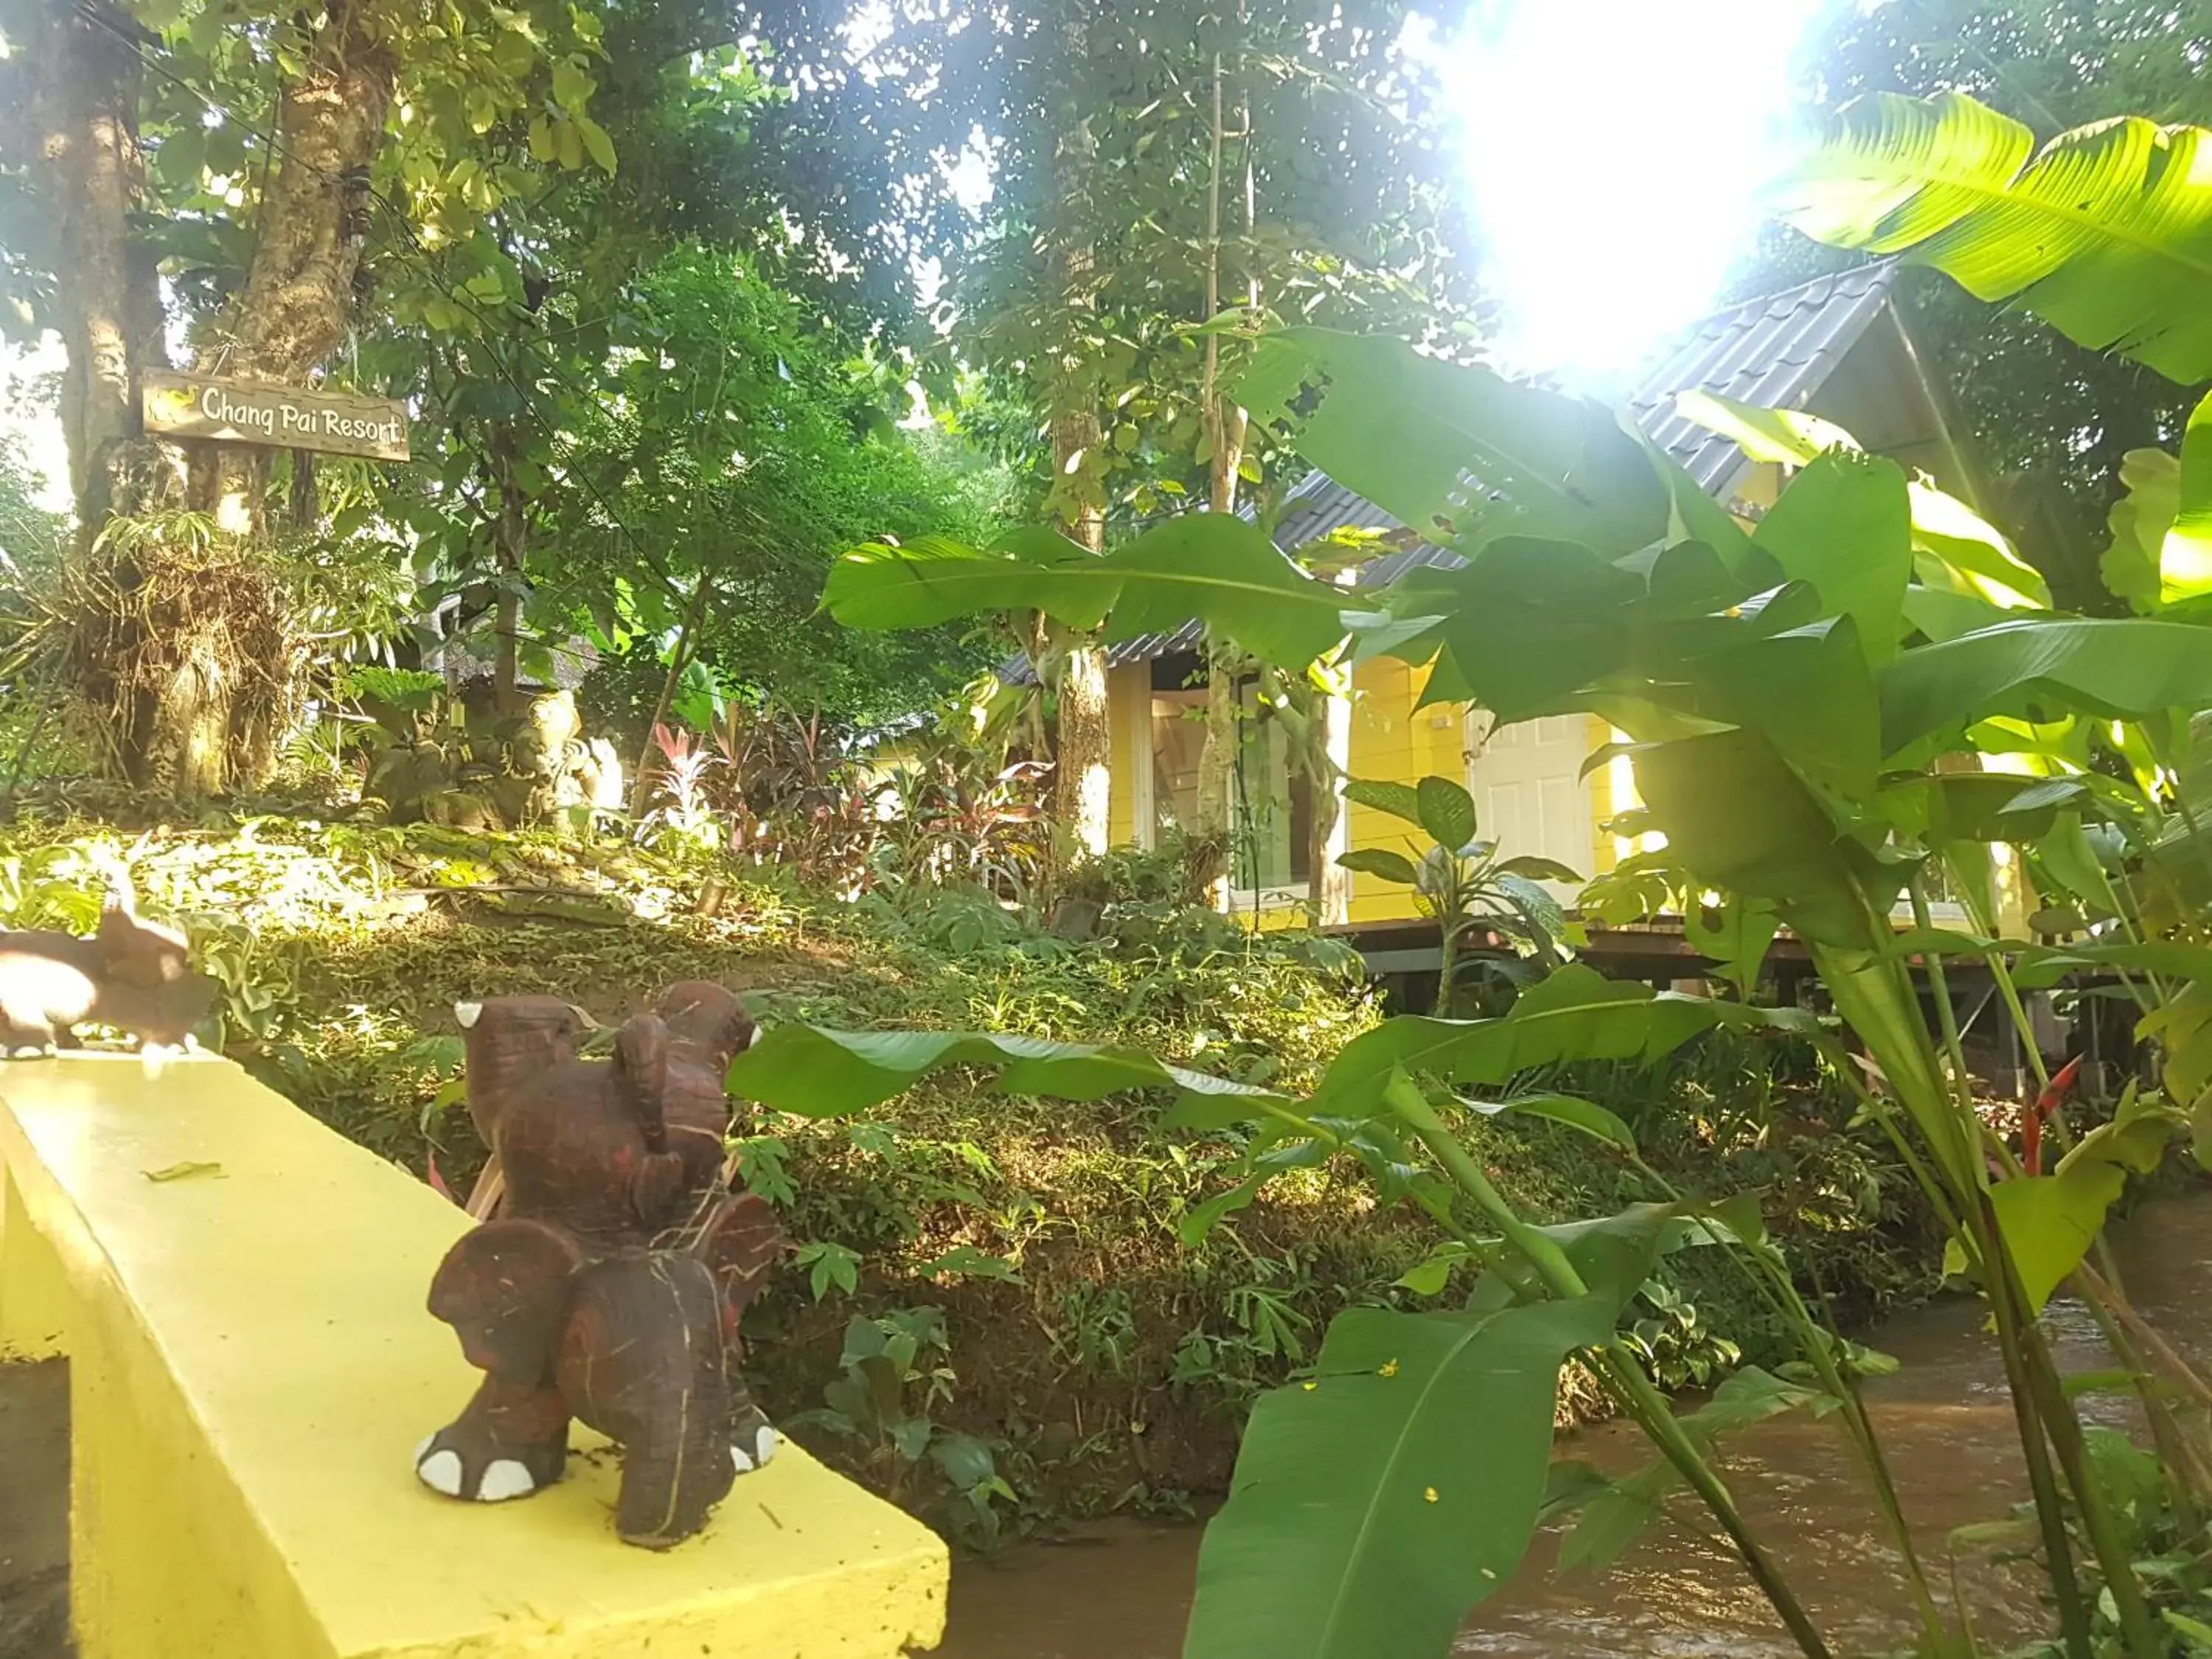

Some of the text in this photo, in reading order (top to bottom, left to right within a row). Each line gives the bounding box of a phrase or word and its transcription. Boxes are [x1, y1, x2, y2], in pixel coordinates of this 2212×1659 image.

[201, 387, 402, 444] Chang Pai Resort
